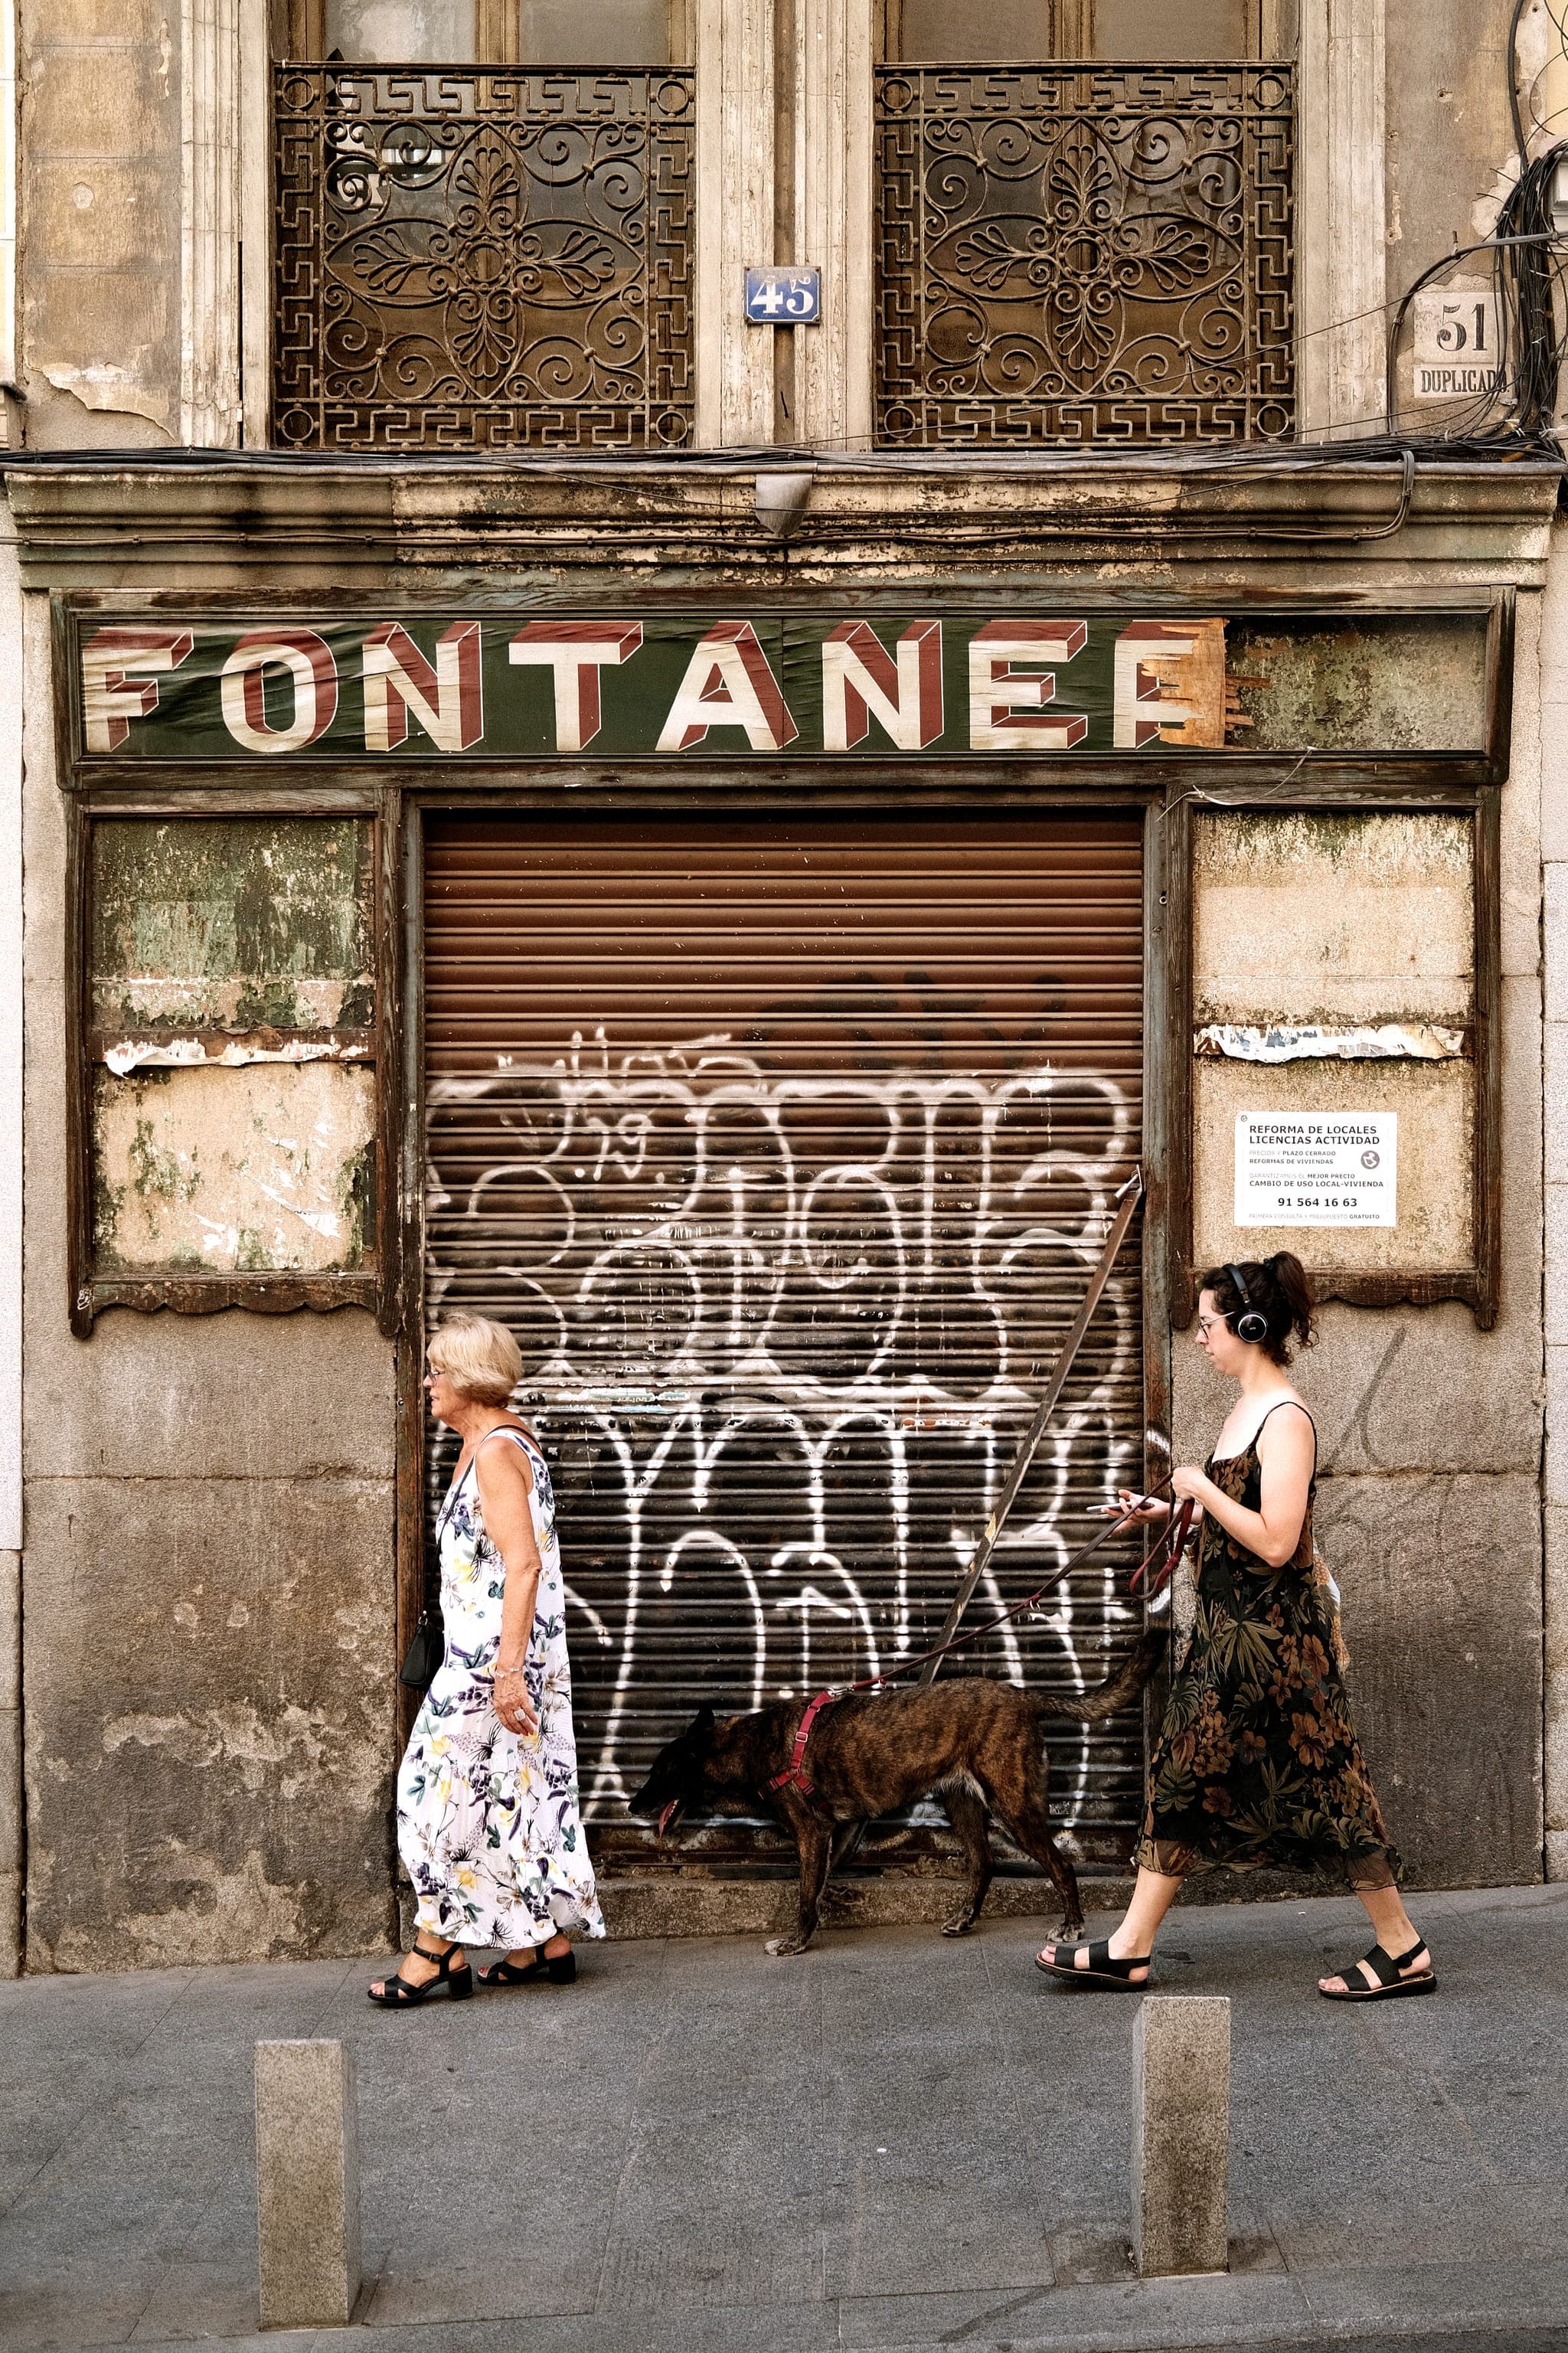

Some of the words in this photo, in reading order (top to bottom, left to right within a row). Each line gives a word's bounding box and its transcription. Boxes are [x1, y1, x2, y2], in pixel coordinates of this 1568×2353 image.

[750, 275, 814, 315] 45
[1436, 303, 1488, 351] 51
[1250, 1125, 1305, 1134] REFORMA
[1308, 1125, 1323, 1134] DE
[1327, 1125, 1377, 1134] LOCALES
[1250, 1136, 1312, 1145] LICENCIAS
[1315, 1136, 1380, 1145] ACTIVIDAD
[1278, 1198, 1292, 1207] 91
[1297, 1198, 1320, 1207] 564
[1325, 1198, 1339, 1207] 16
[1343, 1198, 1357, 1207] 63
